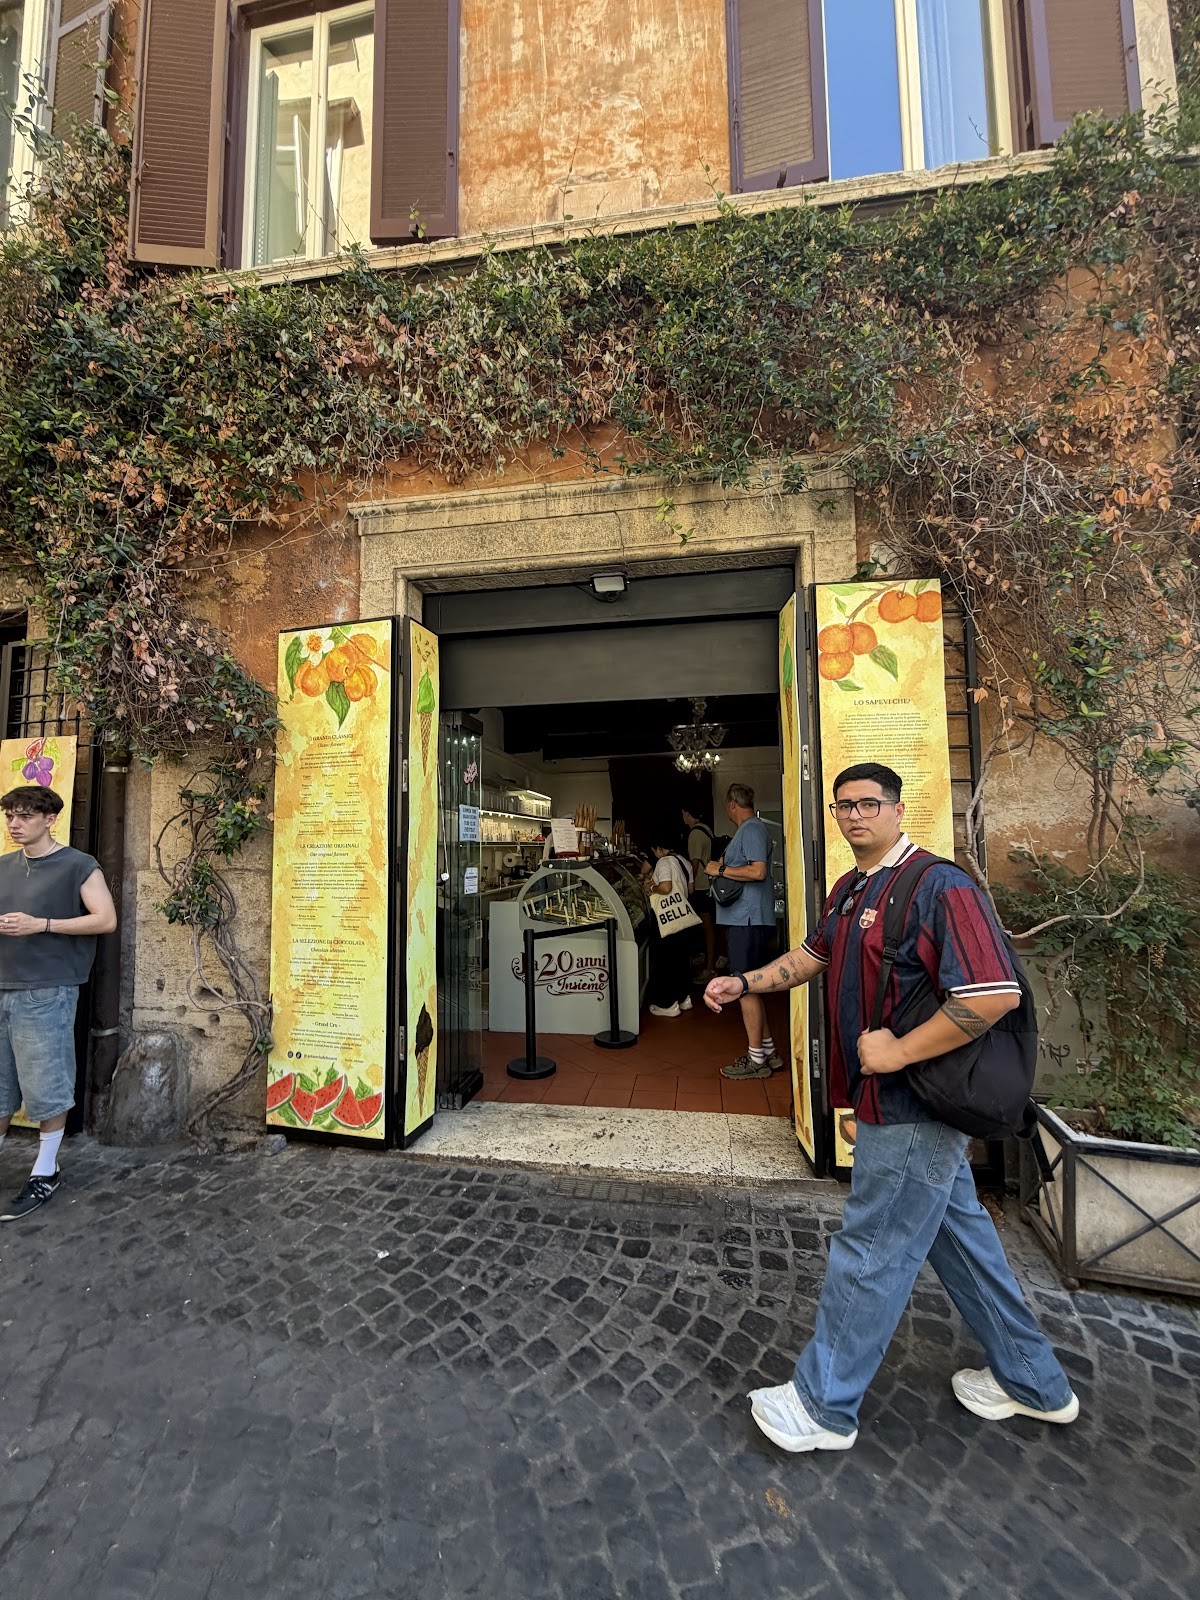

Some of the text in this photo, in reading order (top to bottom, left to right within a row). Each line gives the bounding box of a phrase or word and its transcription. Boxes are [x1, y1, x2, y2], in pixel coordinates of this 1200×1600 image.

[660, 892, 683, 910] CIAO
[659, 904, 693, 926] BELLA
[537, 950, 574, 979] 20
[576, 955, 608, 969] anni
[557, 976, 608, 991] Insieme
